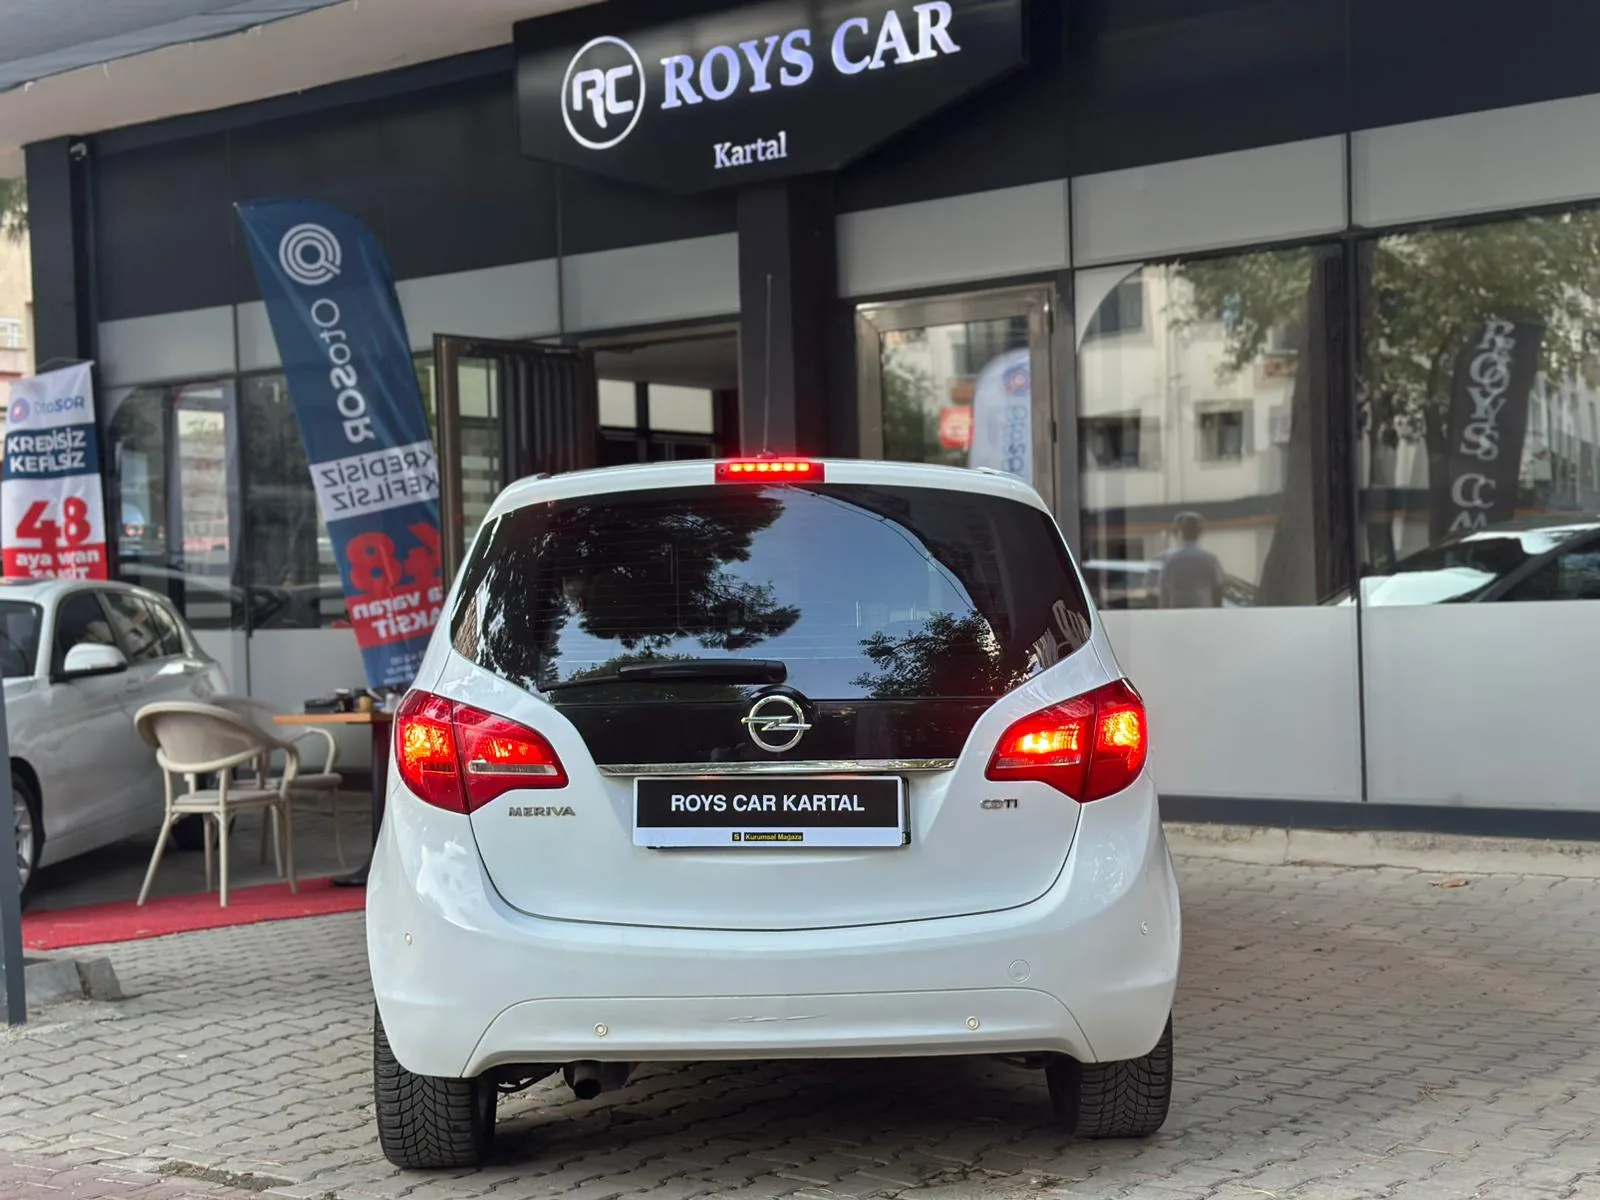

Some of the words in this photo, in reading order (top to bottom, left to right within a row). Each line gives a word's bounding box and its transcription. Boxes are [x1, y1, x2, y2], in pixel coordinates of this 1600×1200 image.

[660, 27, 815, 109] ROYS
[831, 0, 960, 78] CAR
[572, 64, 634, 128] RC
[714, 131, 788, 169] Kartal
[16, 496, 92, 548] 48
[15, 553, 53, 569] aya
[508, 806, 576, 817] MERIVA
[671, 794, 727, 812] ROYS
[733, 794, 776, 812] CAR
[783, 794, 865, 812] KARTAL
